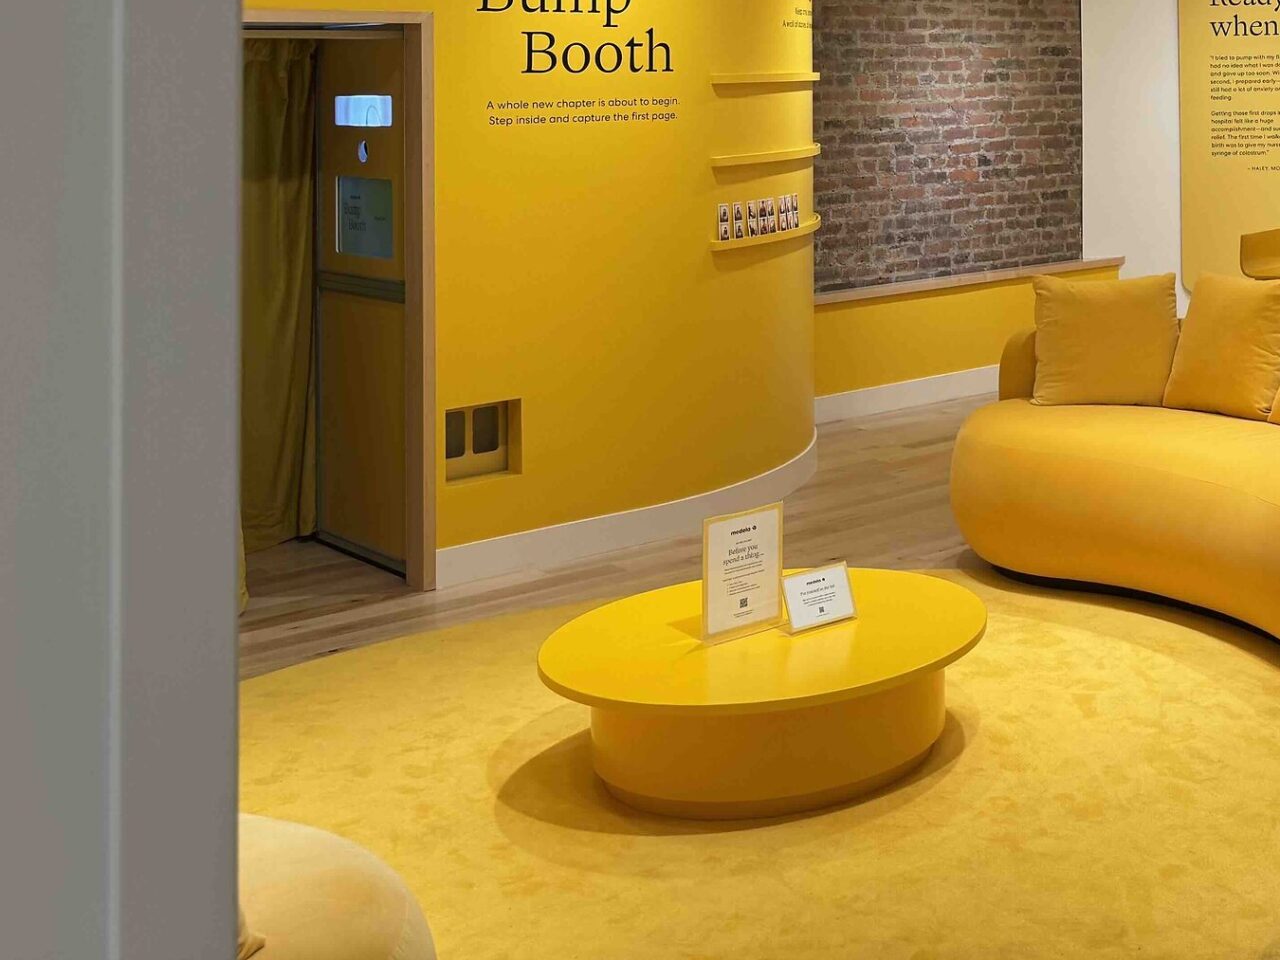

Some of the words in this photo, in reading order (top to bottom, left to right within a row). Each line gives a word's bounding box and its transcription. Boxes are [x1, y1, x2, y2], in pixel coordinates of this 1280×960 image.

[1210, 15, 1279, 37] when
[521, 27, 674, 74] Booth
[487, 101, 494, 109] A
[497, 101, 529, 109] whole
[556, 99, 595, 109] chapter
[599, 98, 605, 106] is
[652, 97, 680, 107] begin.
[489, 116, 513, 126] Step
[516, 115, 546, 124] inside
[549, 114, 569, 123] and
[573, 114, 610, 124] capture
[614, 113, 629, 121] the
[632, 112, 649, 120] first
[652, 112, 677, 122] page.
